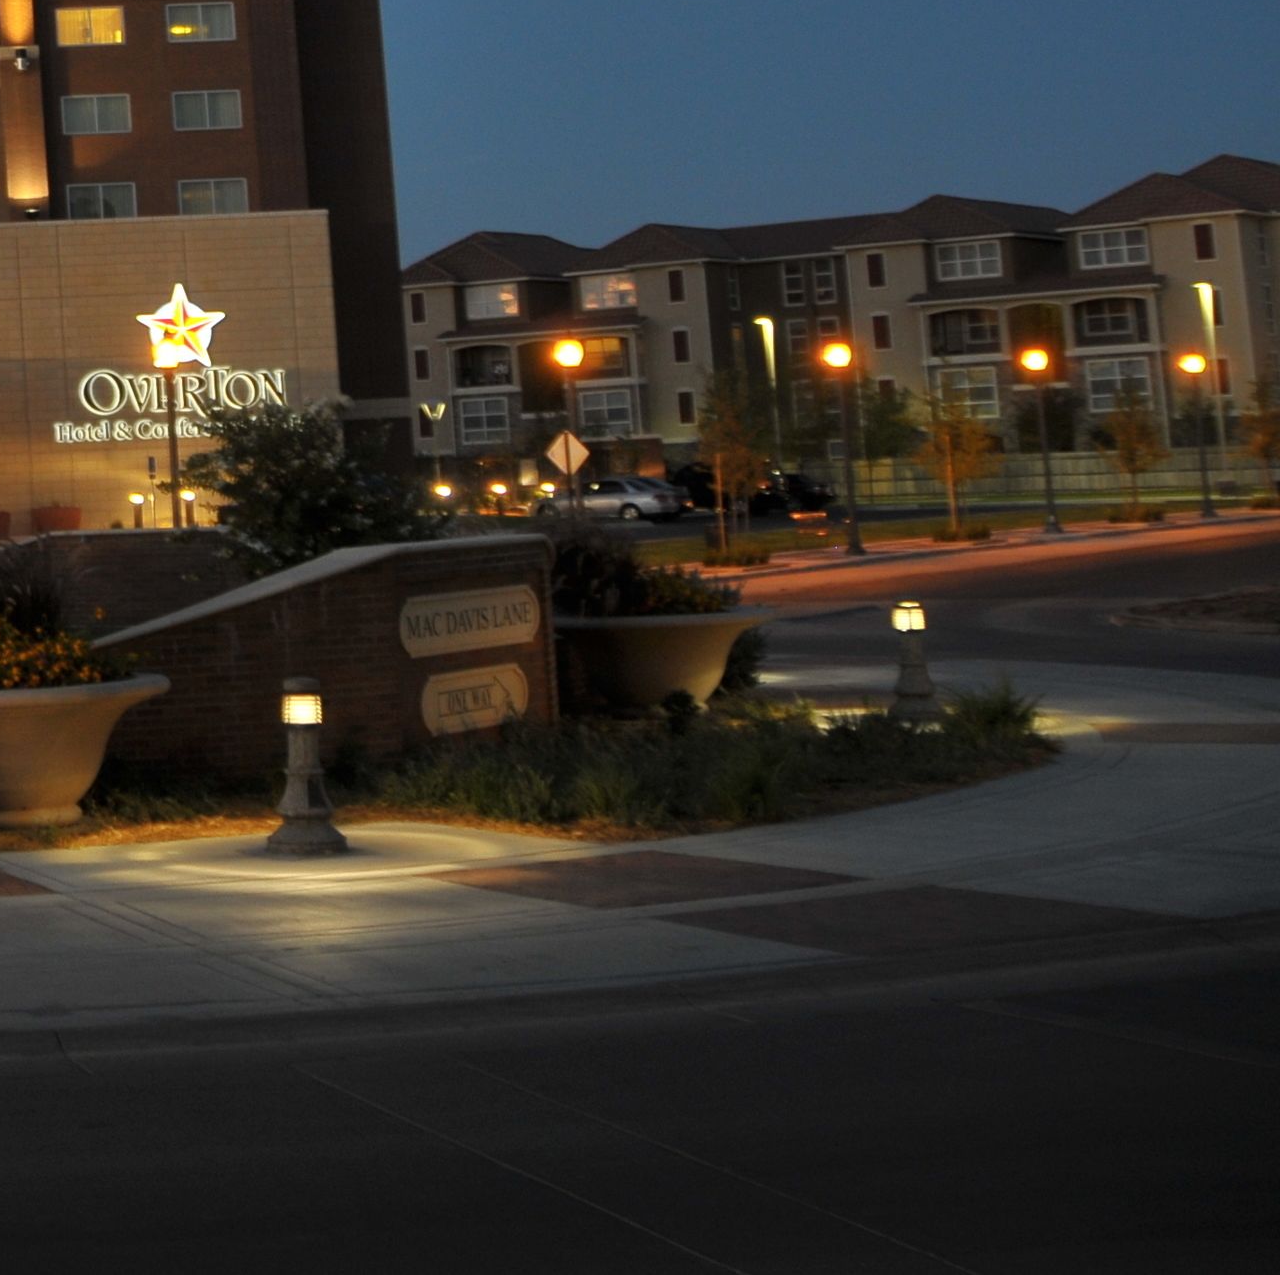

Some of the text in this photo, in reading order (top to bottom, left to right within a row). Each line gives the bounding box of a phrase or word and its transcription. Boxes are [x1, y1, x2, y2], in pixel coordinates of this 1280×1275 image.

[53, 420, 110, 443] Hotel
[113, 420, 133, 441] &
[405, 601, 532, 639] MAC DAVIS LANE
[447, 687, 492, 713] ONE WAY
